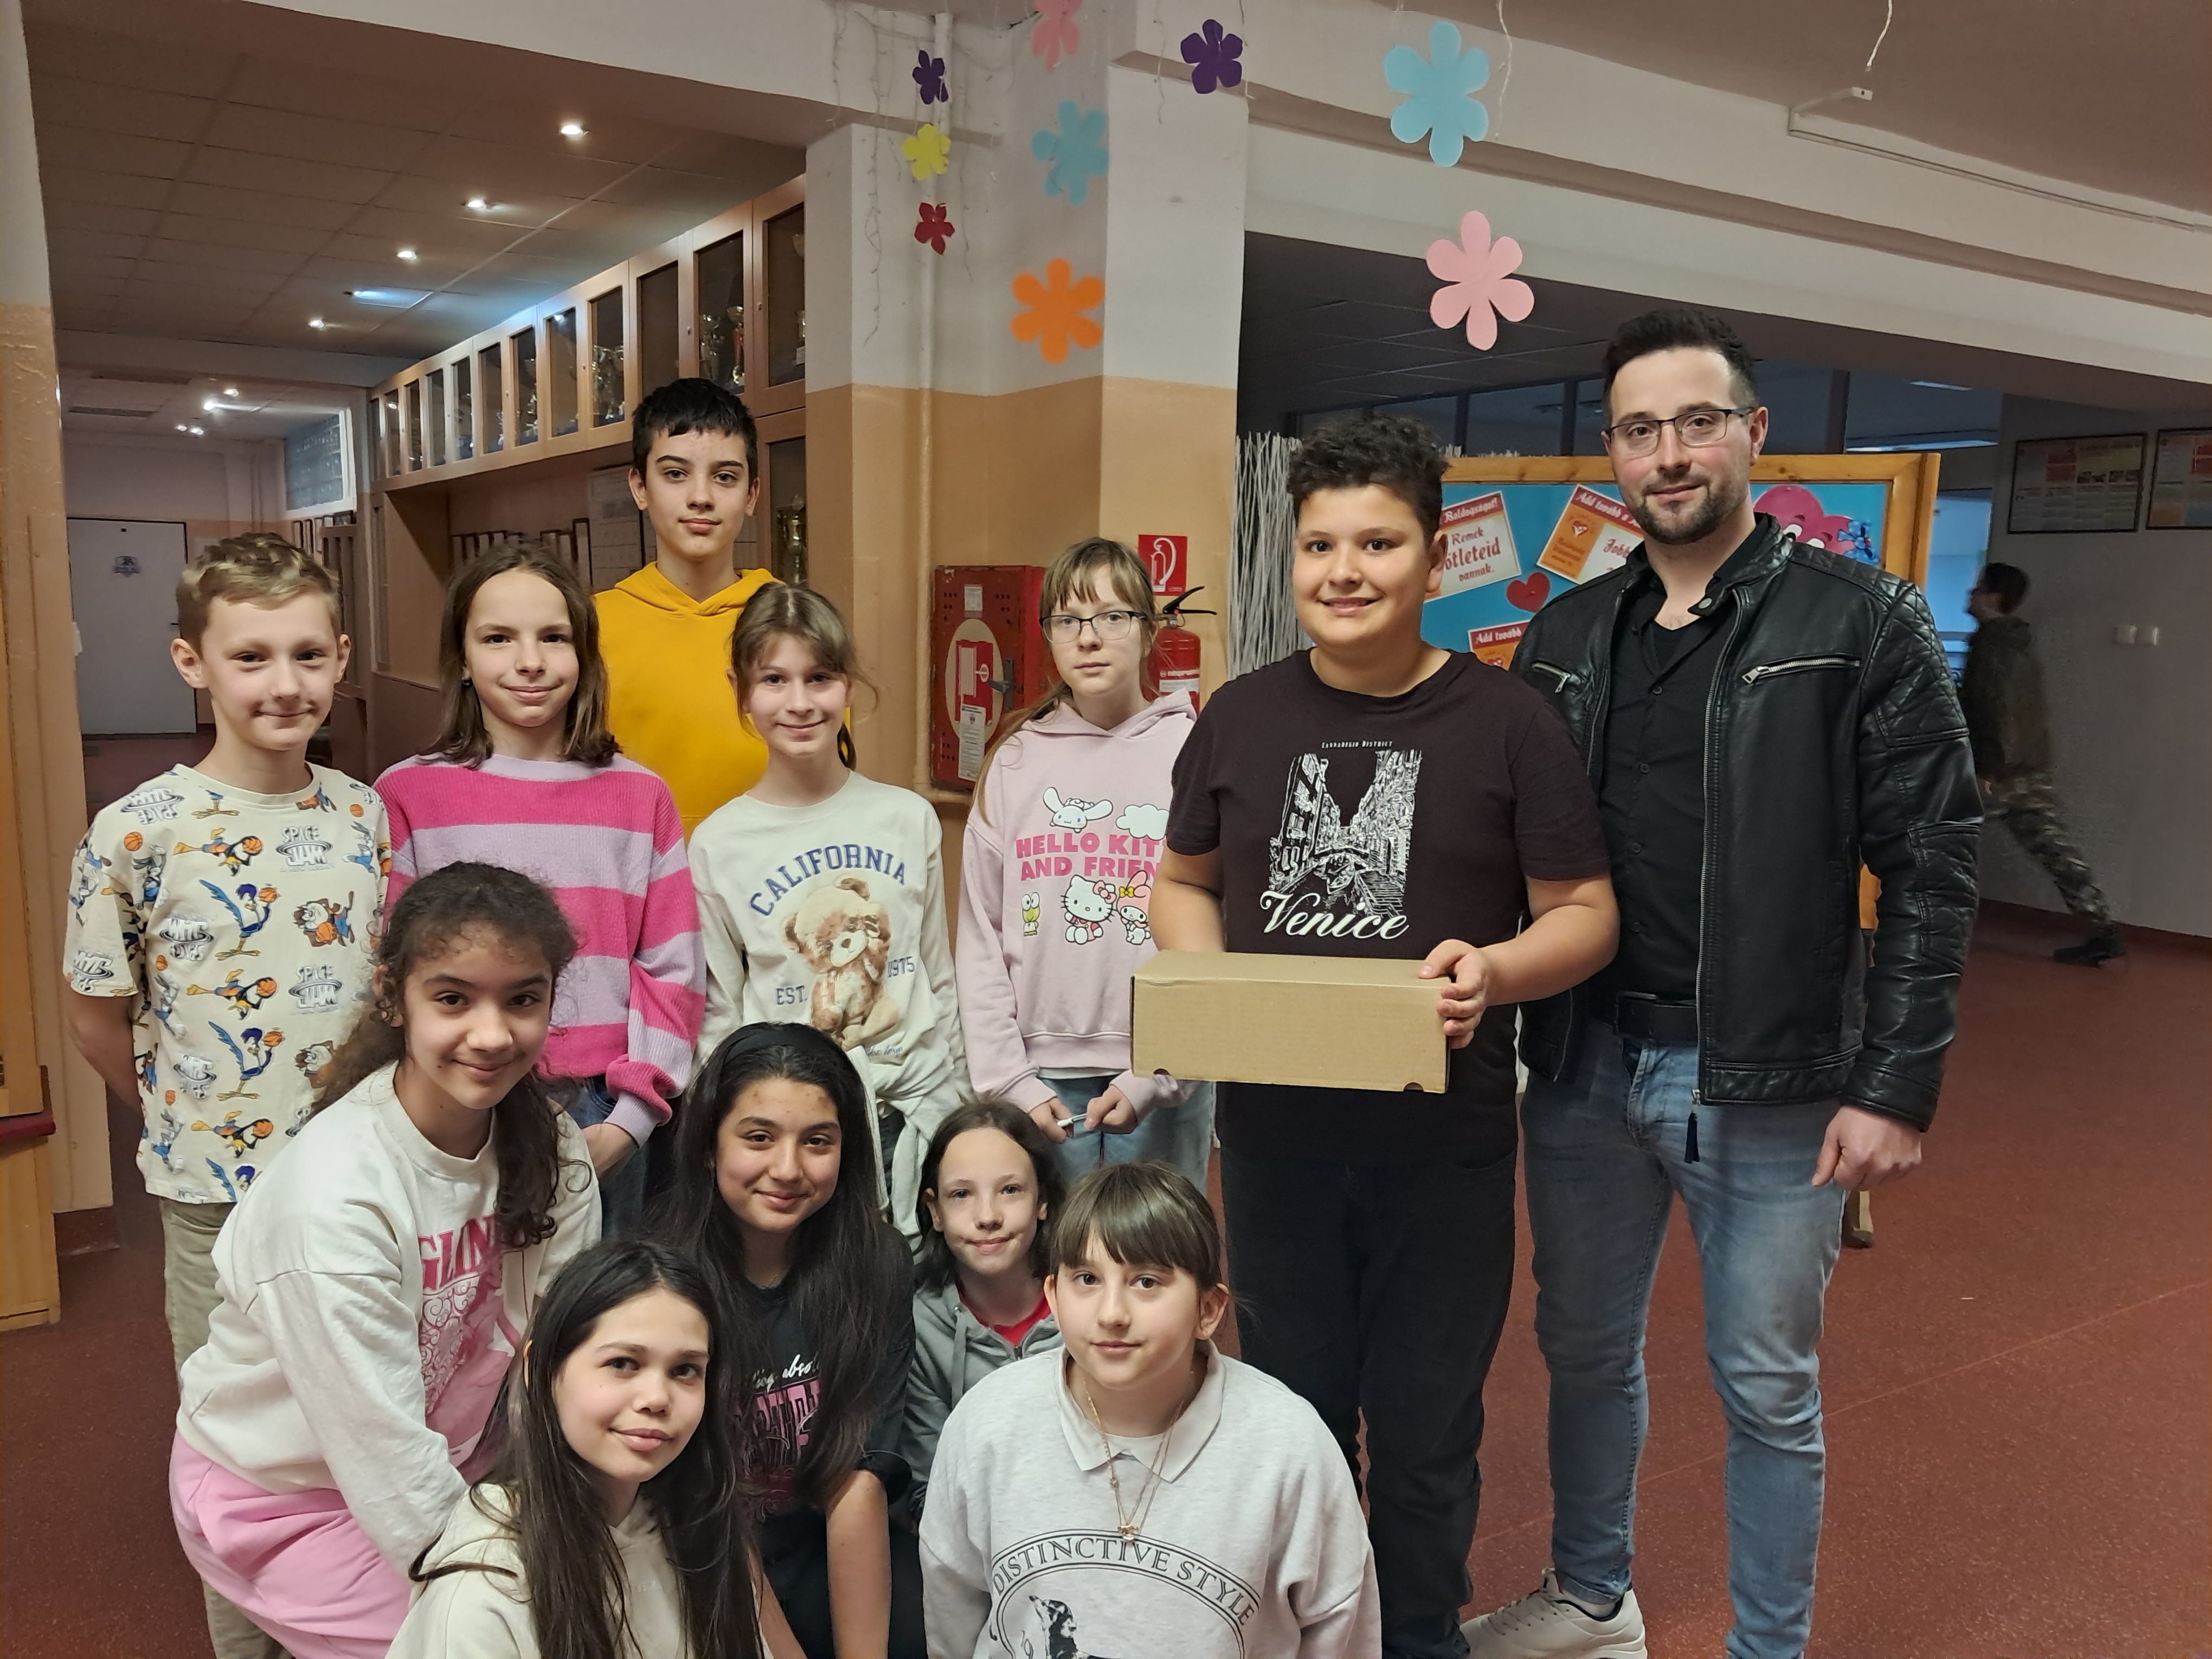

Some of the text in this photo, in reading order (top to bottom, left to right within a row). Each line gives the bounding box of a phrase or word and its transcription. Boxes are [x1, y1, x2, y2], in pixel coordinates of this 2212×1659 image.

[1451, 526, 1484, 545] Remek
[281, 825, 320, 843] SPACE
[1015, 832, 1167, 859] HELLO KIT
[750, 844, 905, 916] CALIFORNIA
[1021, 857, 1072, 881] AND
[1259, 890, 1410, 940] Venice
[296, 963, 335, 984] SPACE
[775, 956, 916, 1005] EST. 1975
[993, 1536, 1256, 1626] DISTINCTIVE STYLE
